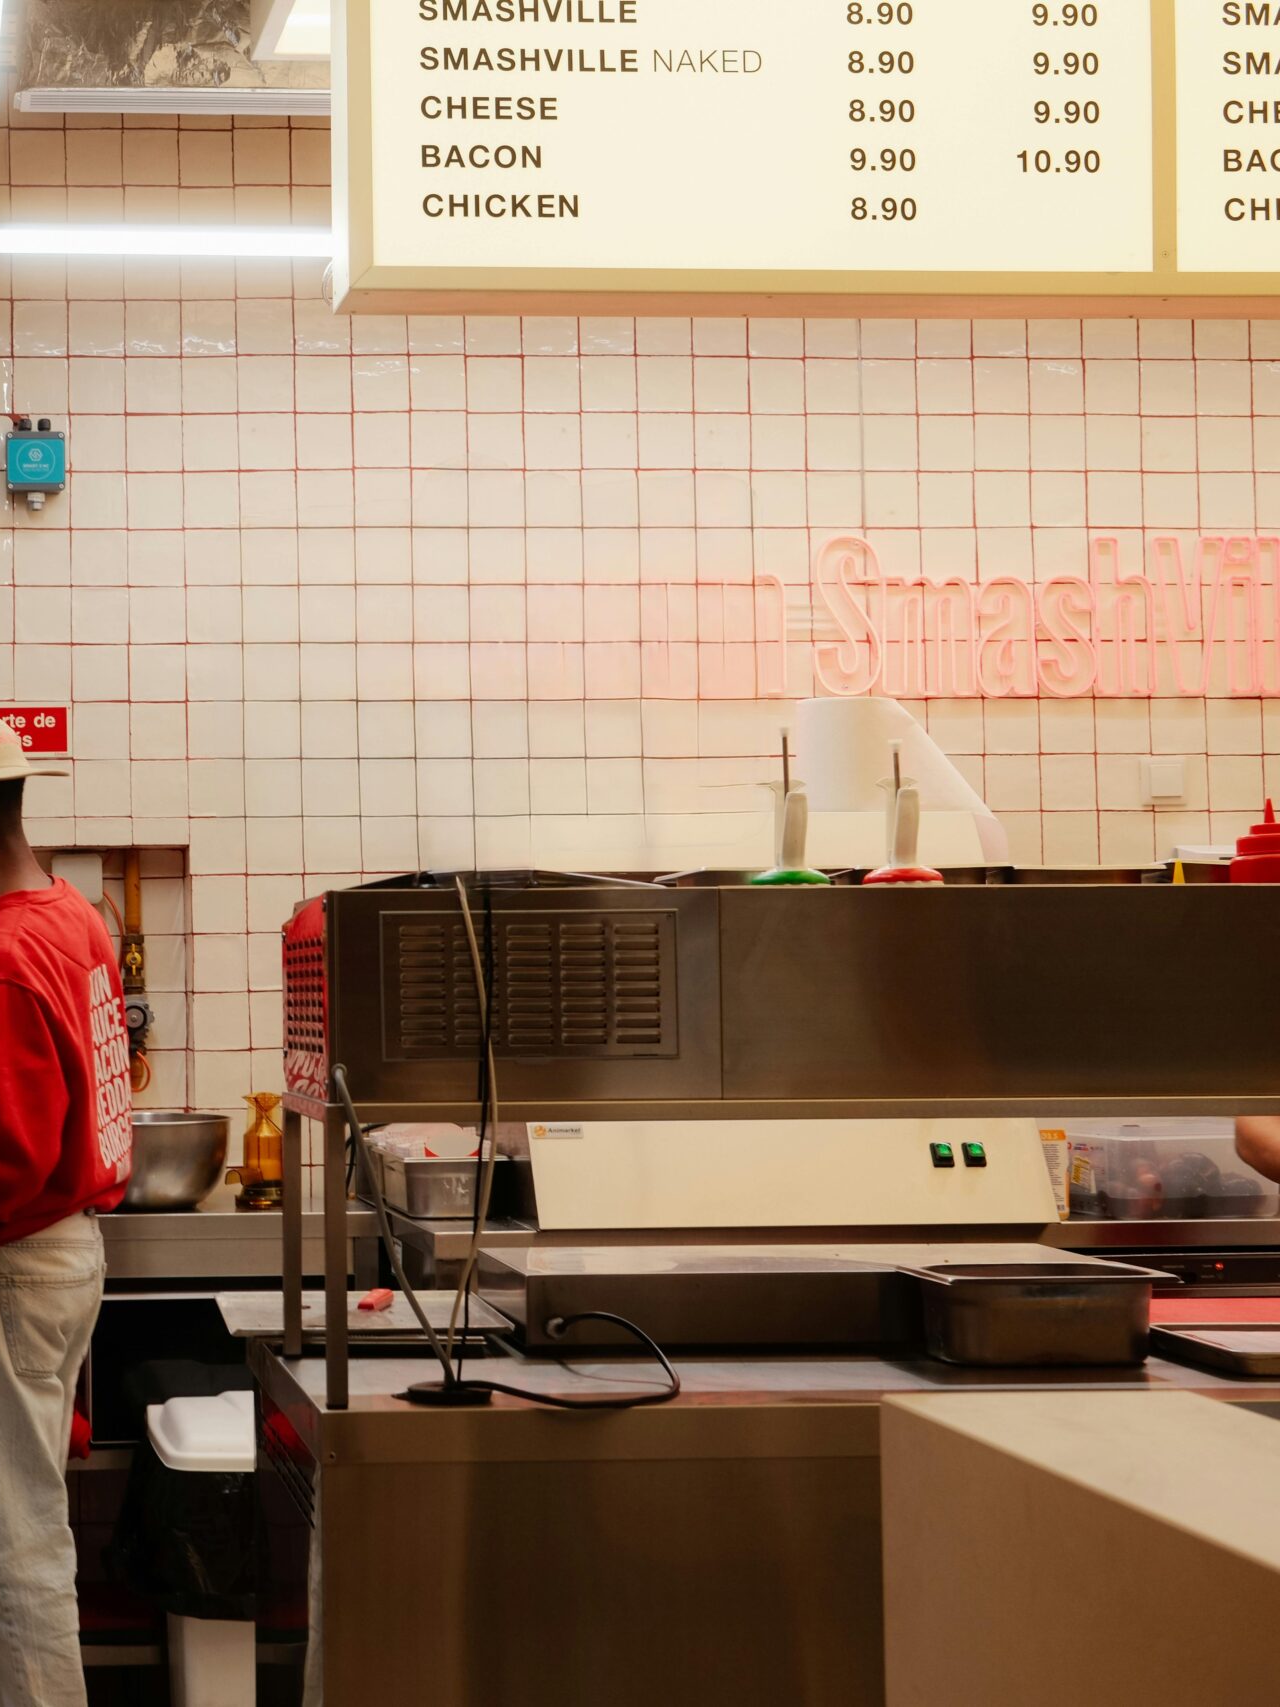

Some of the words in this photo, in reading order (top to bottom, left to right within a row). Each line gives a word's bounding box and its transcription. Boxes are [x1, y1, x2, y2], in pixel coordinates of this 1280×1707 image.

[419, 0, 637, 23] SMASHVILLE
[847, 2, 913, 25] 8.90
[1032, 4, 1098, 27] 9.90
[1222, 2, 1280, 26] SM
[420, 47, 638, 72] SMASHVILLE
[654, 49, 762, 73] NAKED
[848, 51, 914, 75] 8.90
[1033, 52, 1099, 75] 9.90
[1223, 52, 1280, 75] SM
[421, 96, 558, 120] CHEESE
[849, 99, 914, 122] 8.90
[1034, 101, 1099, 124] 9.90
[421, 145, 542, 168] BACON
[850, 148, 915, 172] 9.90
[1017, 150, 1100, 174] 10.90
[423, 194, 579, 218] CHICKEN
[851, 197, 916, 221] 8.90
[2, 713, 26, 728] rte
[33, 712, 56, 728] de
